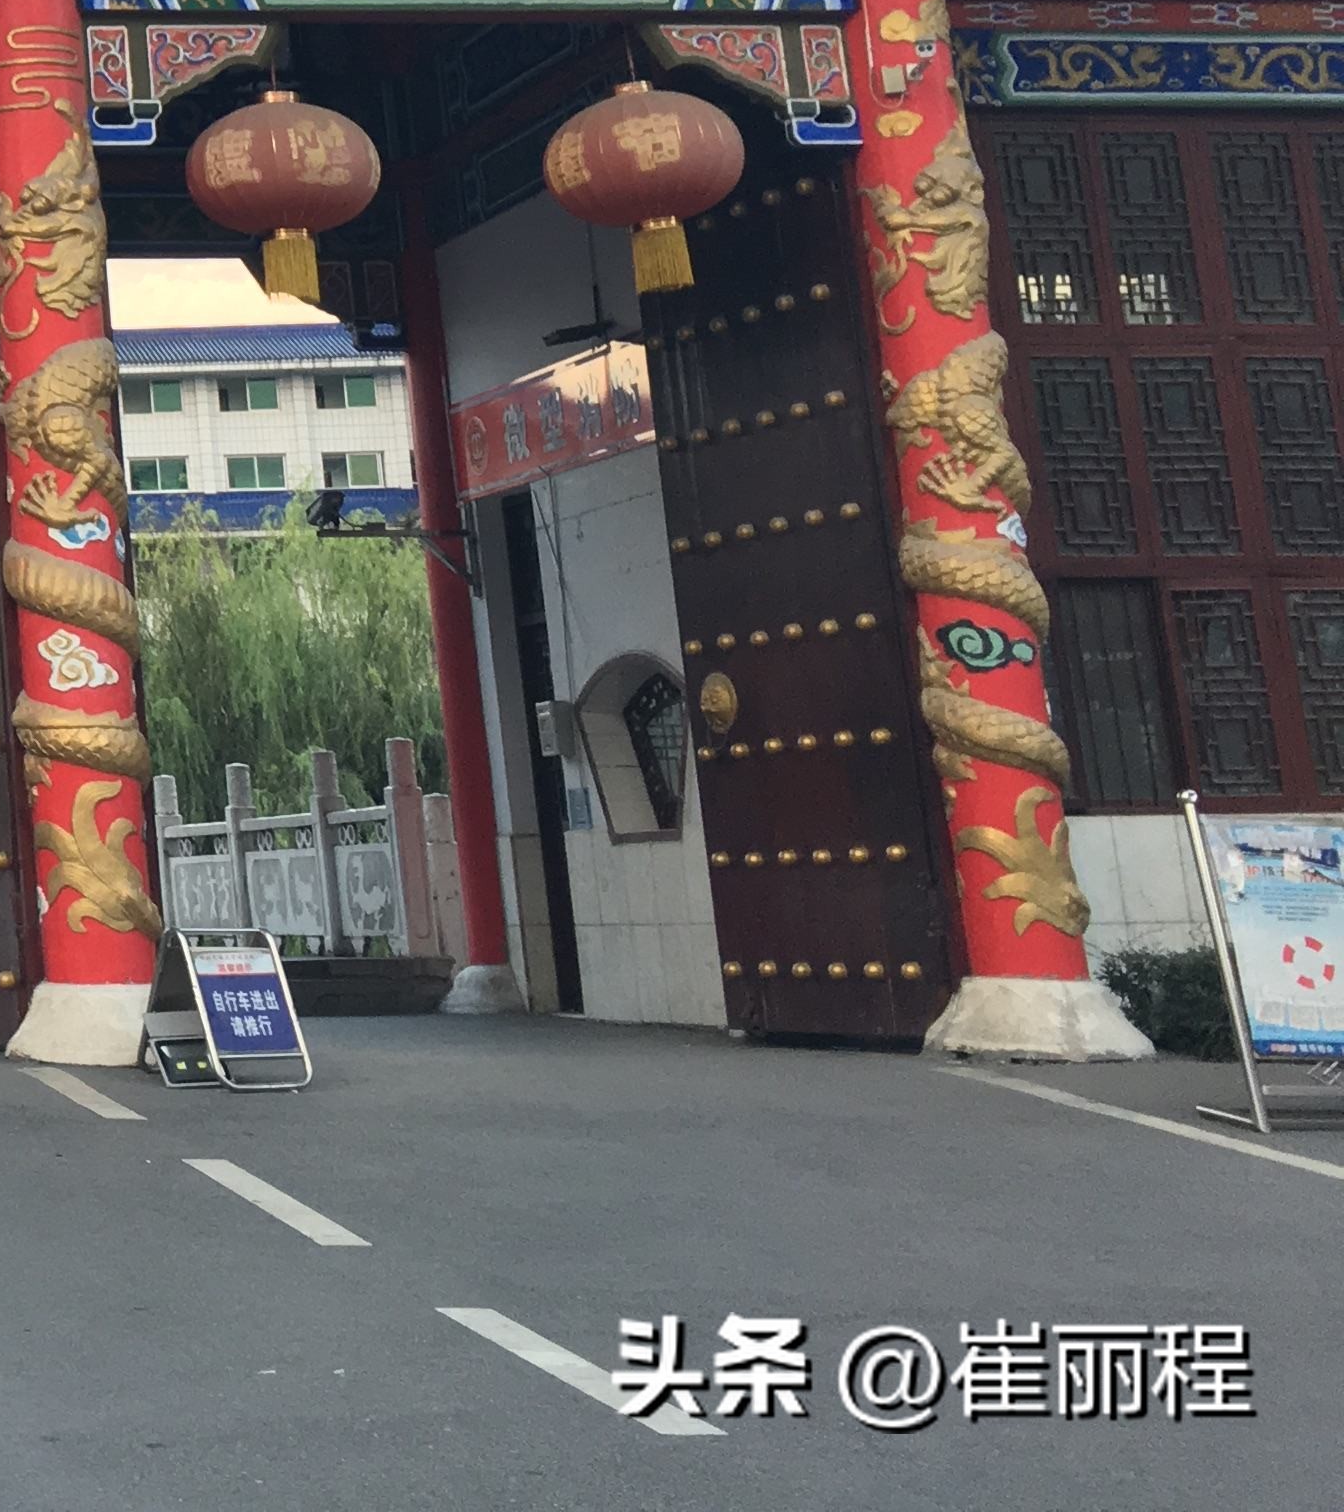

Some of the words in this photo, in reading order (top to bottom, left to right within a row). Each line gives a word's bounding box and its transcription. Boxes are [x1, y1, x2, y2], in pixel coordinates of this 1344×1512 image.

[213, 990, 279, 1012] 自行车进出
[230, 1015, 273, 1037] 请推行
